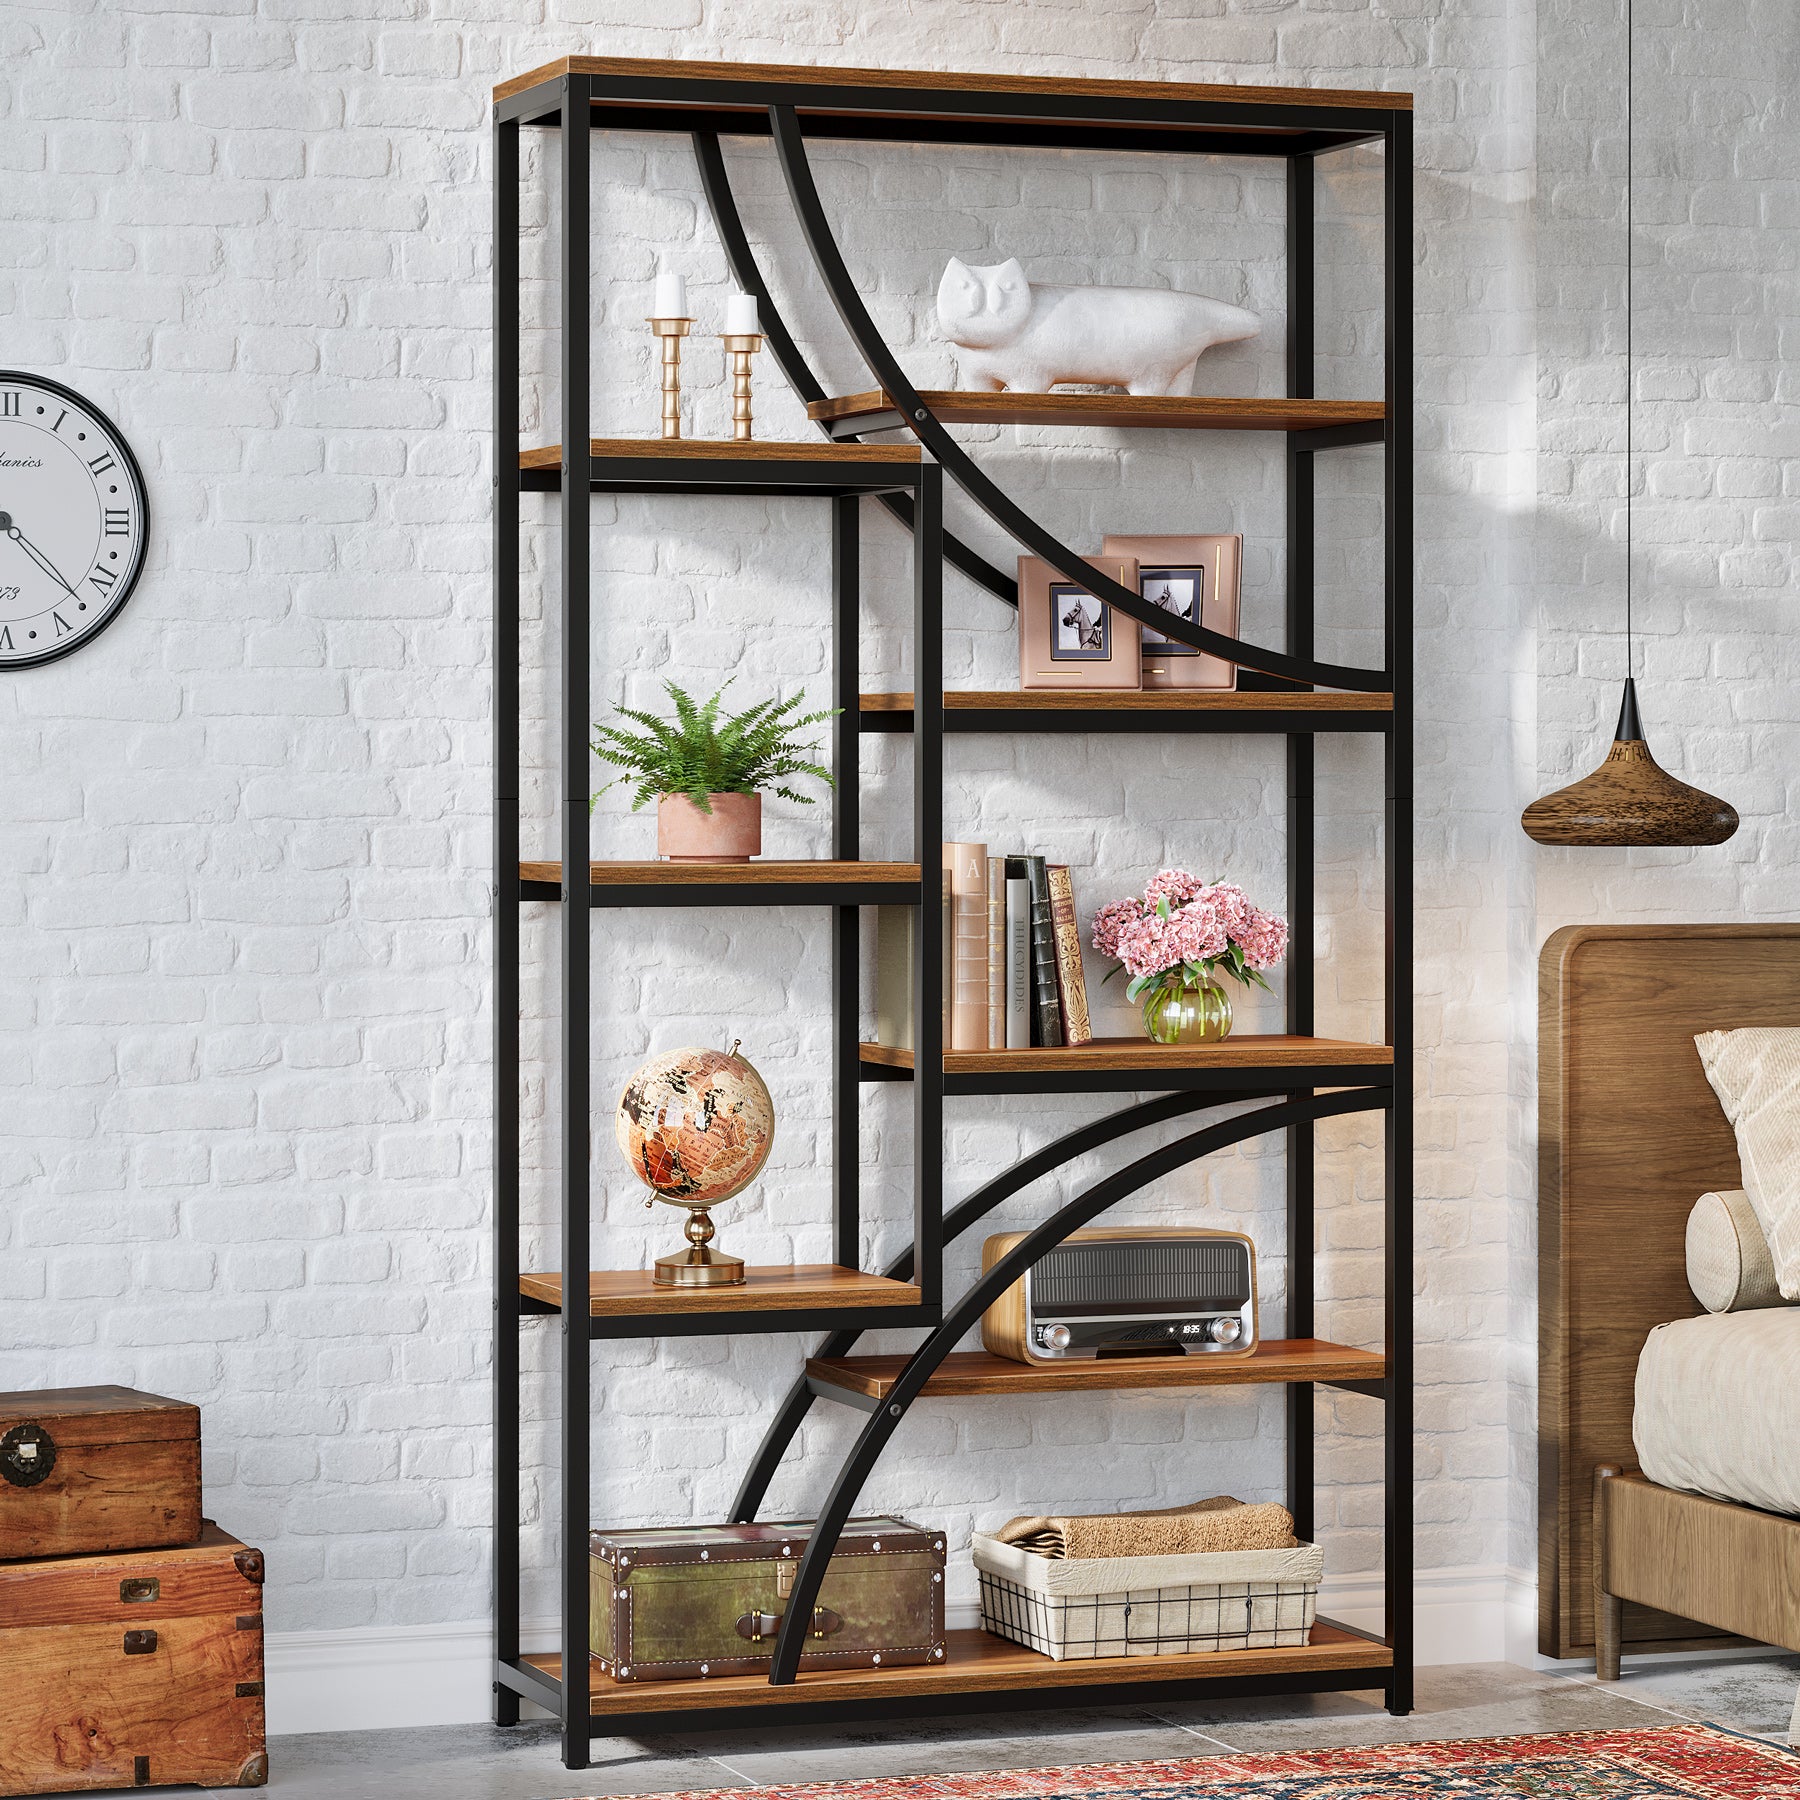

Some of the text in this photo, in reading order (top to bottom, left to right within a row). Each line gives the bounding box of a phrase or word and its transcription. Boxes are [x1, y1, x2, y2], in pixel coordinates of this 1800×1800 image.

[104, 507, 130, 538] III
[88, 562, 119, 599] IV
[52, 611, 74, 638] V
[966, 858, 981, 879] A
[1015, 917, 1025, 1013] THUCYDIDES
